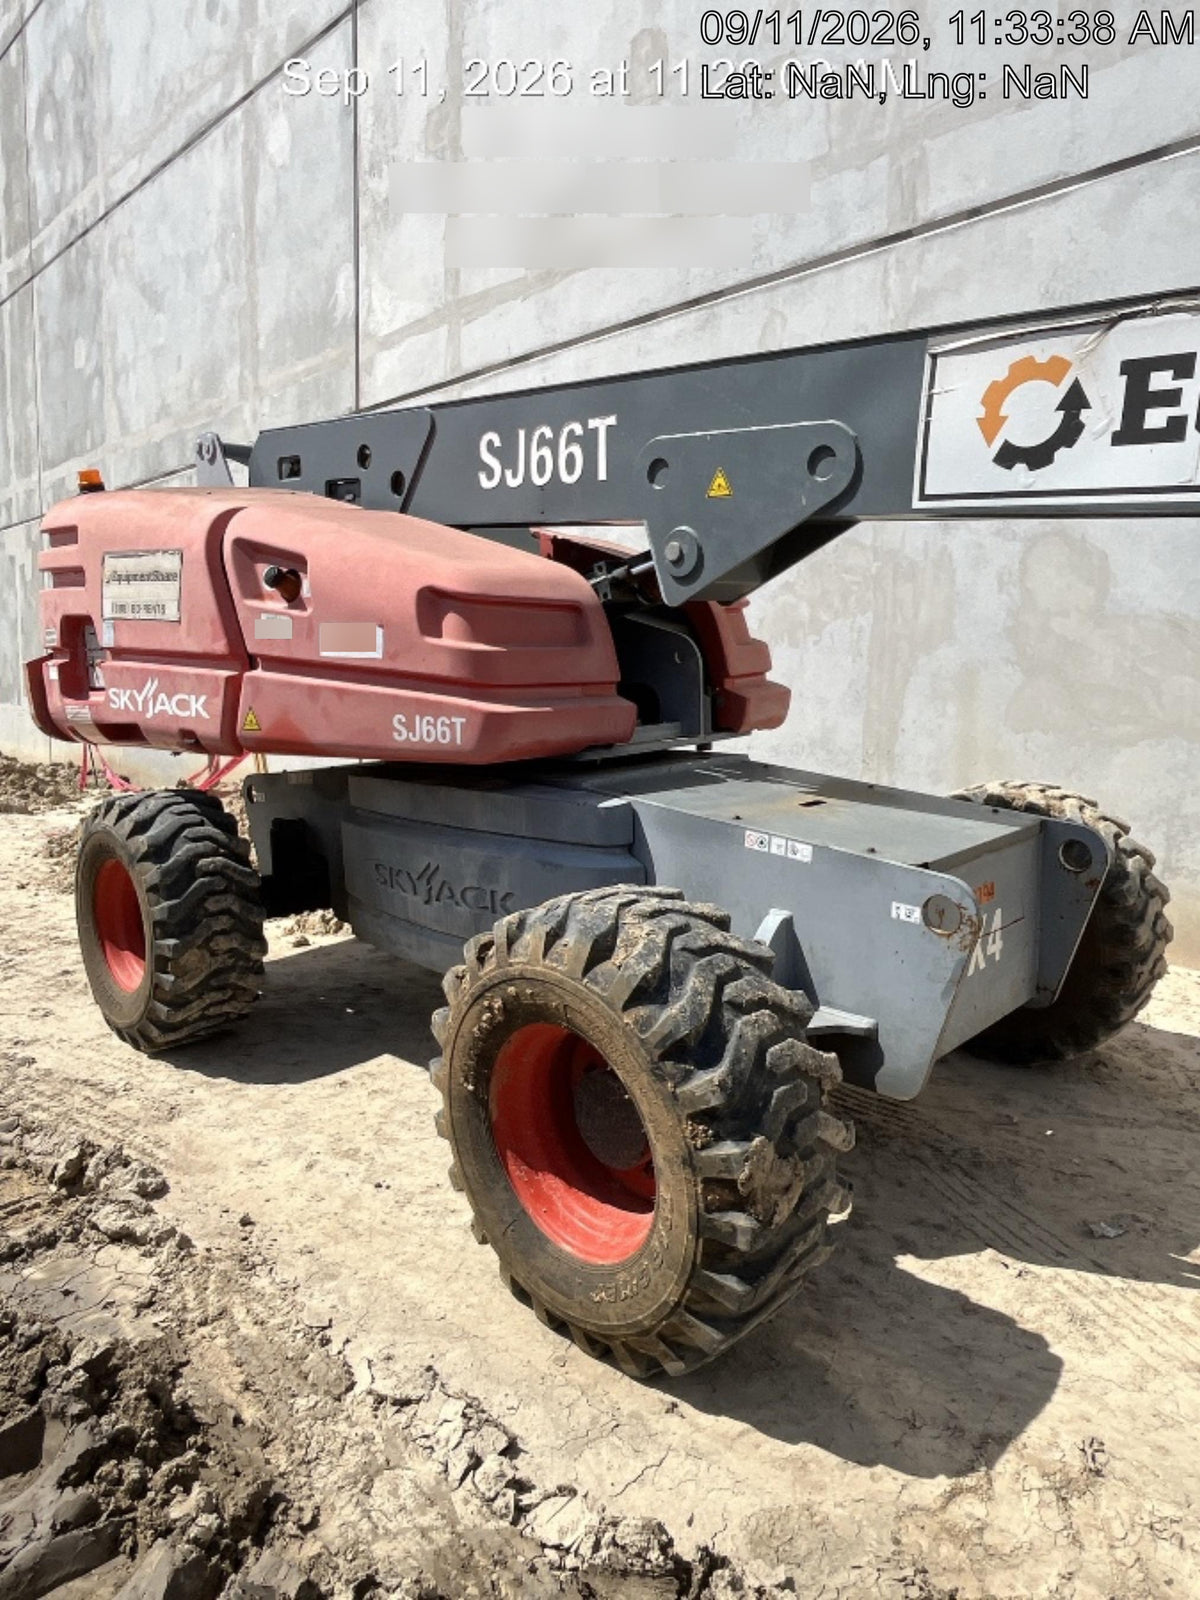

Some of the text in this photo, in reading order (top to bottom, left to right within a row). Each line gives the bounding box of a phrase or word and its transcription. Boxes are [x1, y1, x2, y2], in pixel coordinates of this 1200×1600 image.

[1111, 352, 1200, 447] E
[478, 414, 617, 490] SJ66T
[108, 676, 211, 719] SKYJACK
[392, 713, 467, 746] SJ66T
[374, 861, 515, 914] SKYJACK
